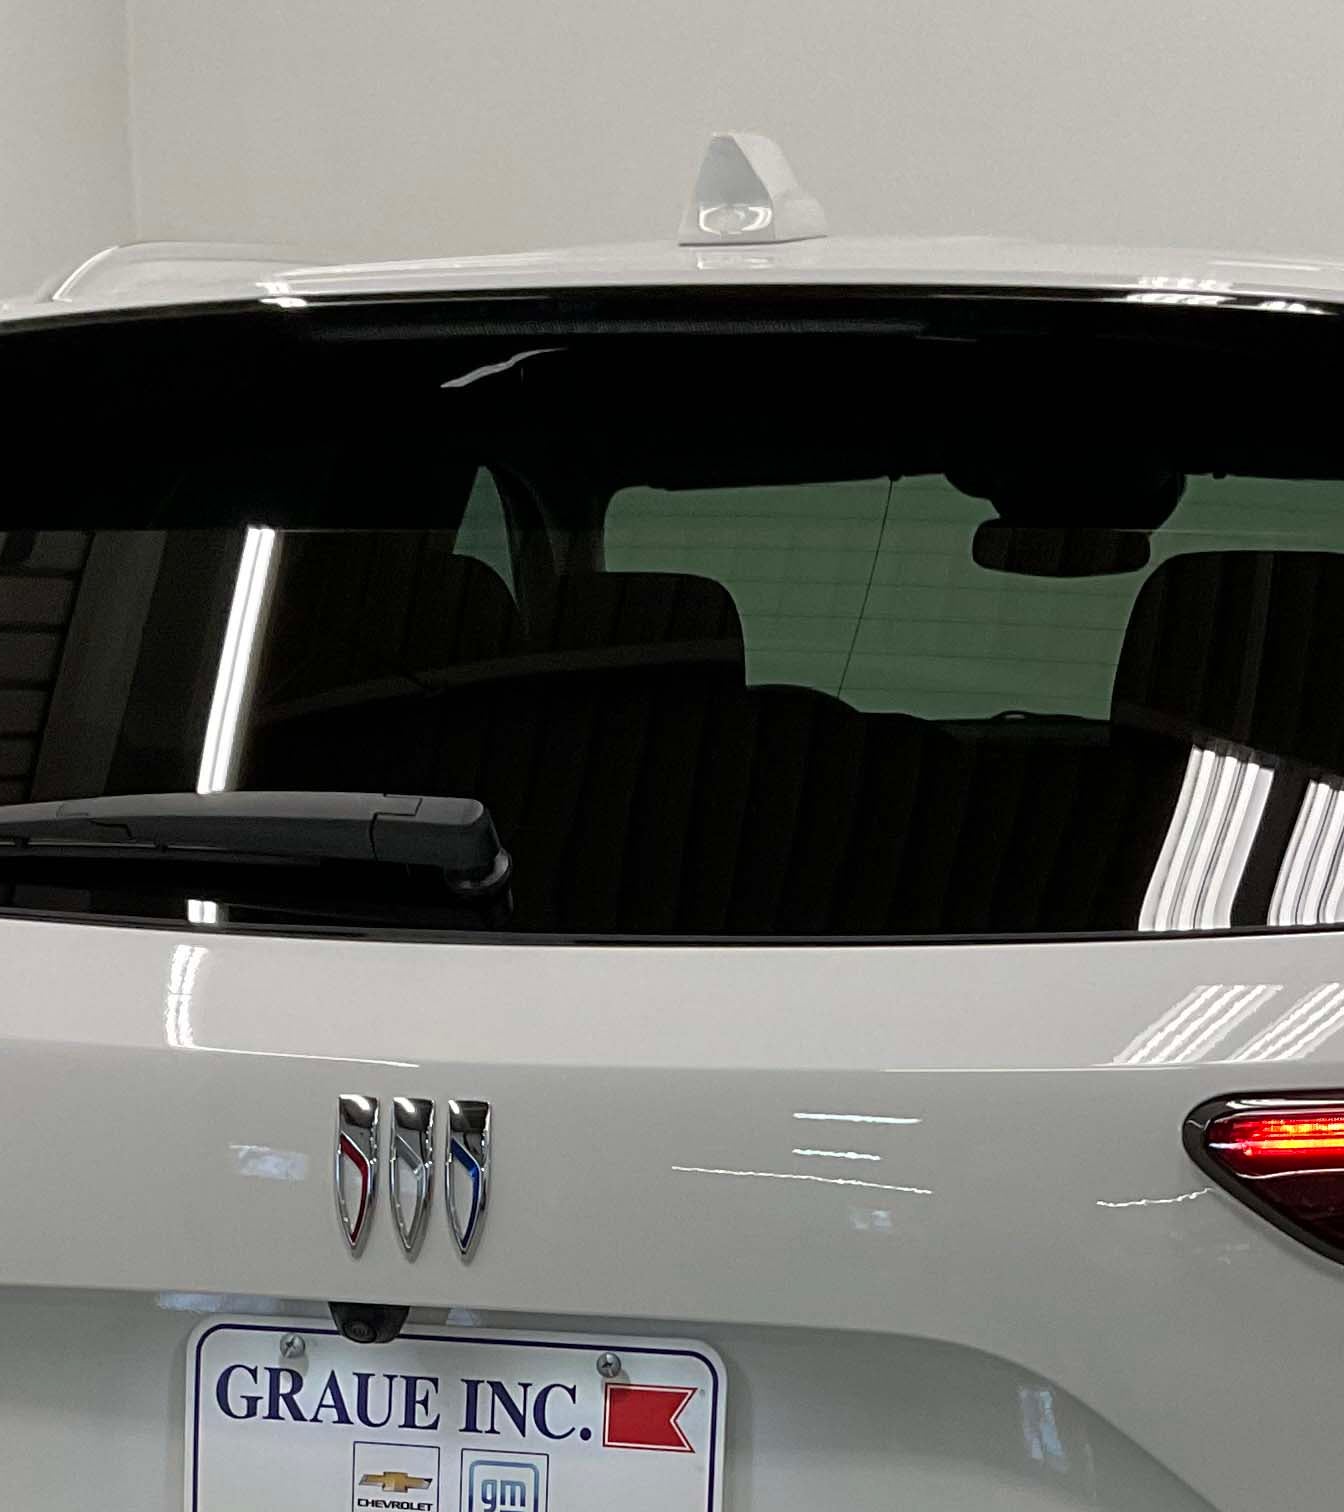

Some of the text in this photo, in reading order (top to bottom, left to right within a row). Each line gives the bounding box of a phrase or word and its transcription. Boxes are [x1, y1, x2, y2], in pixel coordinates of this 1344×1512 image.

[215, 1363, 592, 1442] GRAUE INC.
[356, 1497, 434, 1512] CHEVROLET
